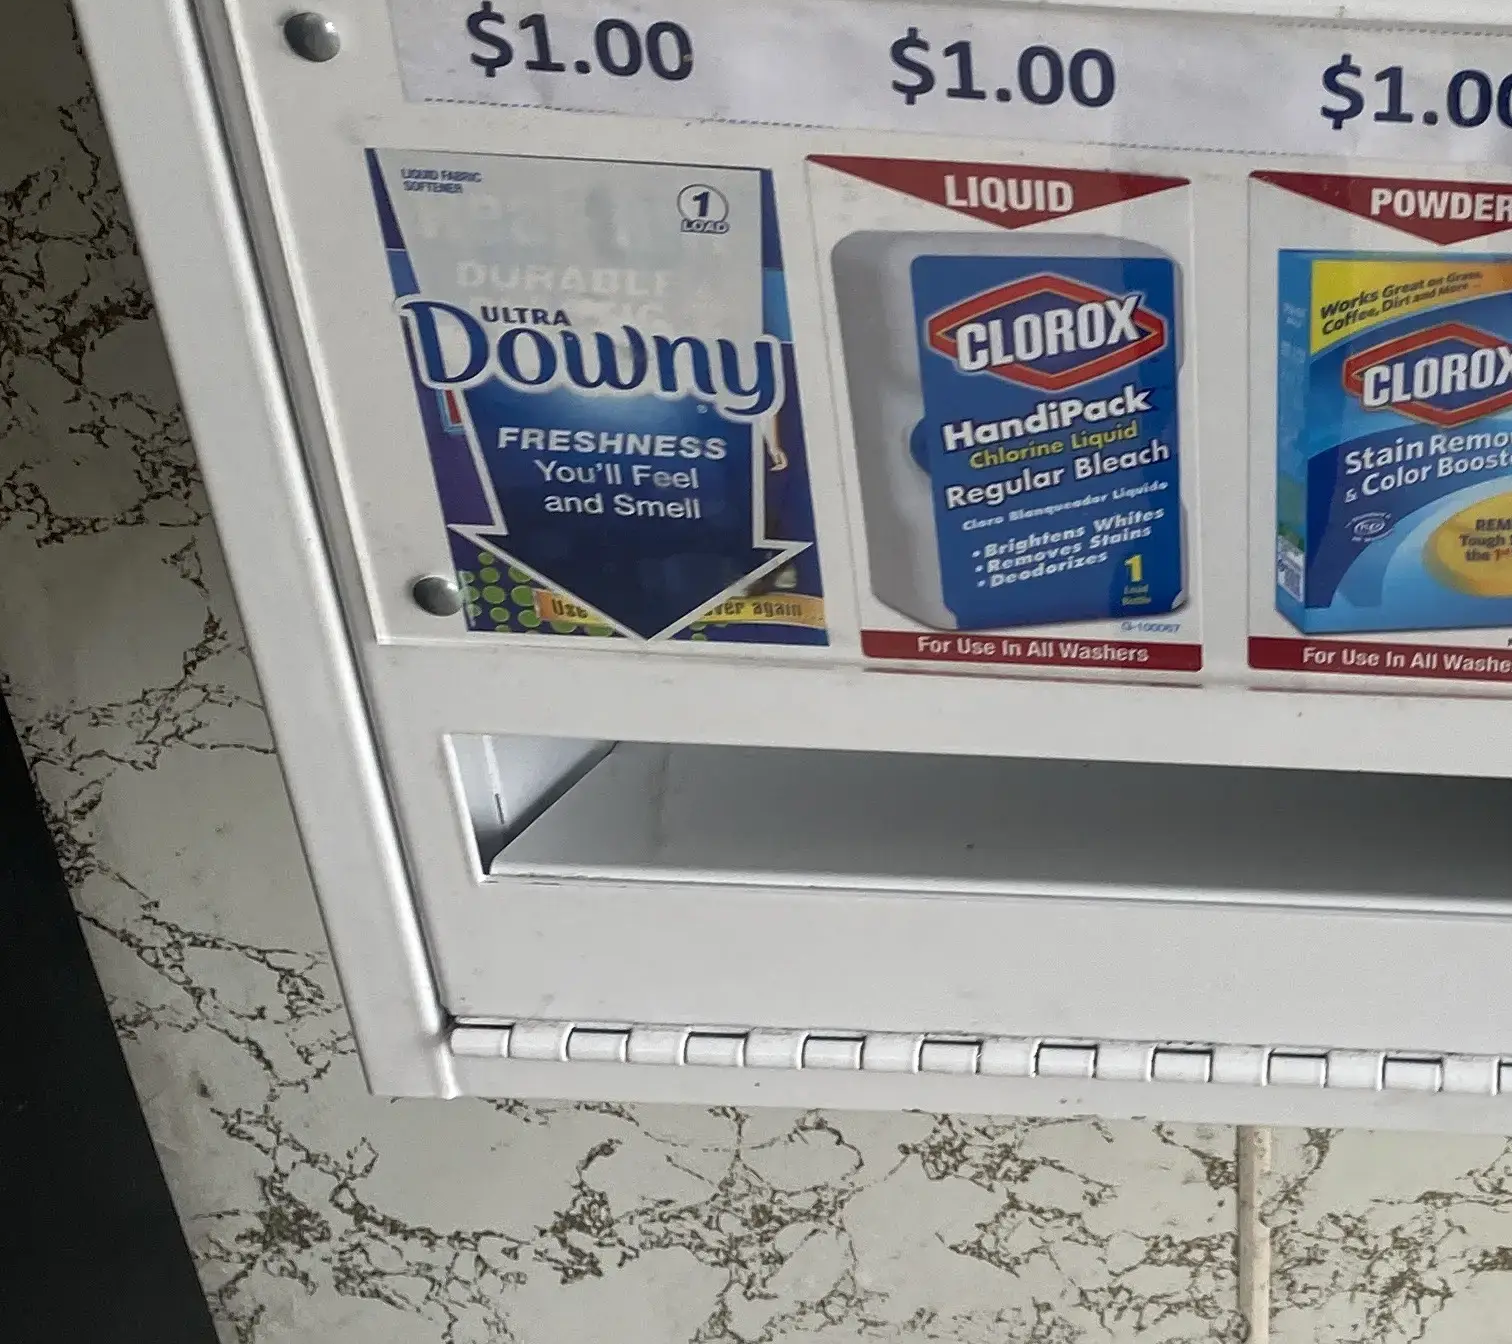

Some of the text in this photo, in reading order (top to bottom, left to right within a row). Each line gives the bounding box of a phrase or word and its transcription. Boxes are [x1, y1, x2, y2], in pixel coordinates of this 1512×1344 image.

[465, 0, 694, 81] $1.00
[890, 26, 1116, 107] $1.00
[692, 191, 710, 217] 1
[945, 175, 1073, 213] LIQUID
[680, 218, 730, 234] LOAD
[481, 306, 572, 326] ULTRA
[1320, 290, 1378, 320] Works
[1382, 279, 1424, 298] Great
[1382, 296, 1409, 315] Dirt
[955, 295, 1142, 372] CLOROX
[398, 298, 780, 419] Downy
[943, 384, 1153, 451] HandiPack
[498, 427, 727, 459] FRESHNESS
[970, 420, 1139, 469] Chlorine Liquid
[1345, 437, 1423, 475] Stain
[535, 460, 699, 489] You'll Feel
[947, 439, 1170, 509] Regular Bleach
[1344, 488, 1358, 504] &
[1362, 463, 1430, 497] Color
[544, 492, 701, 519] and Smell
[984, 508, 1165, 557] Brightens Whites
[987, 526, 1152, 573] Removes Stains
[1459, 534, 1505, 548] Tough
[990, 552, 1108, 588] Deodorizes
[1124, 554, 1142, 582] 1
[917, 636, 1149, 662] For Use In All Washers
[1303, 647, 1334, 666] For
[1341, 650, 1379, 668] Use
[1385, 651, 1405, 669] In
[1410, 652, 1437, 670] All
